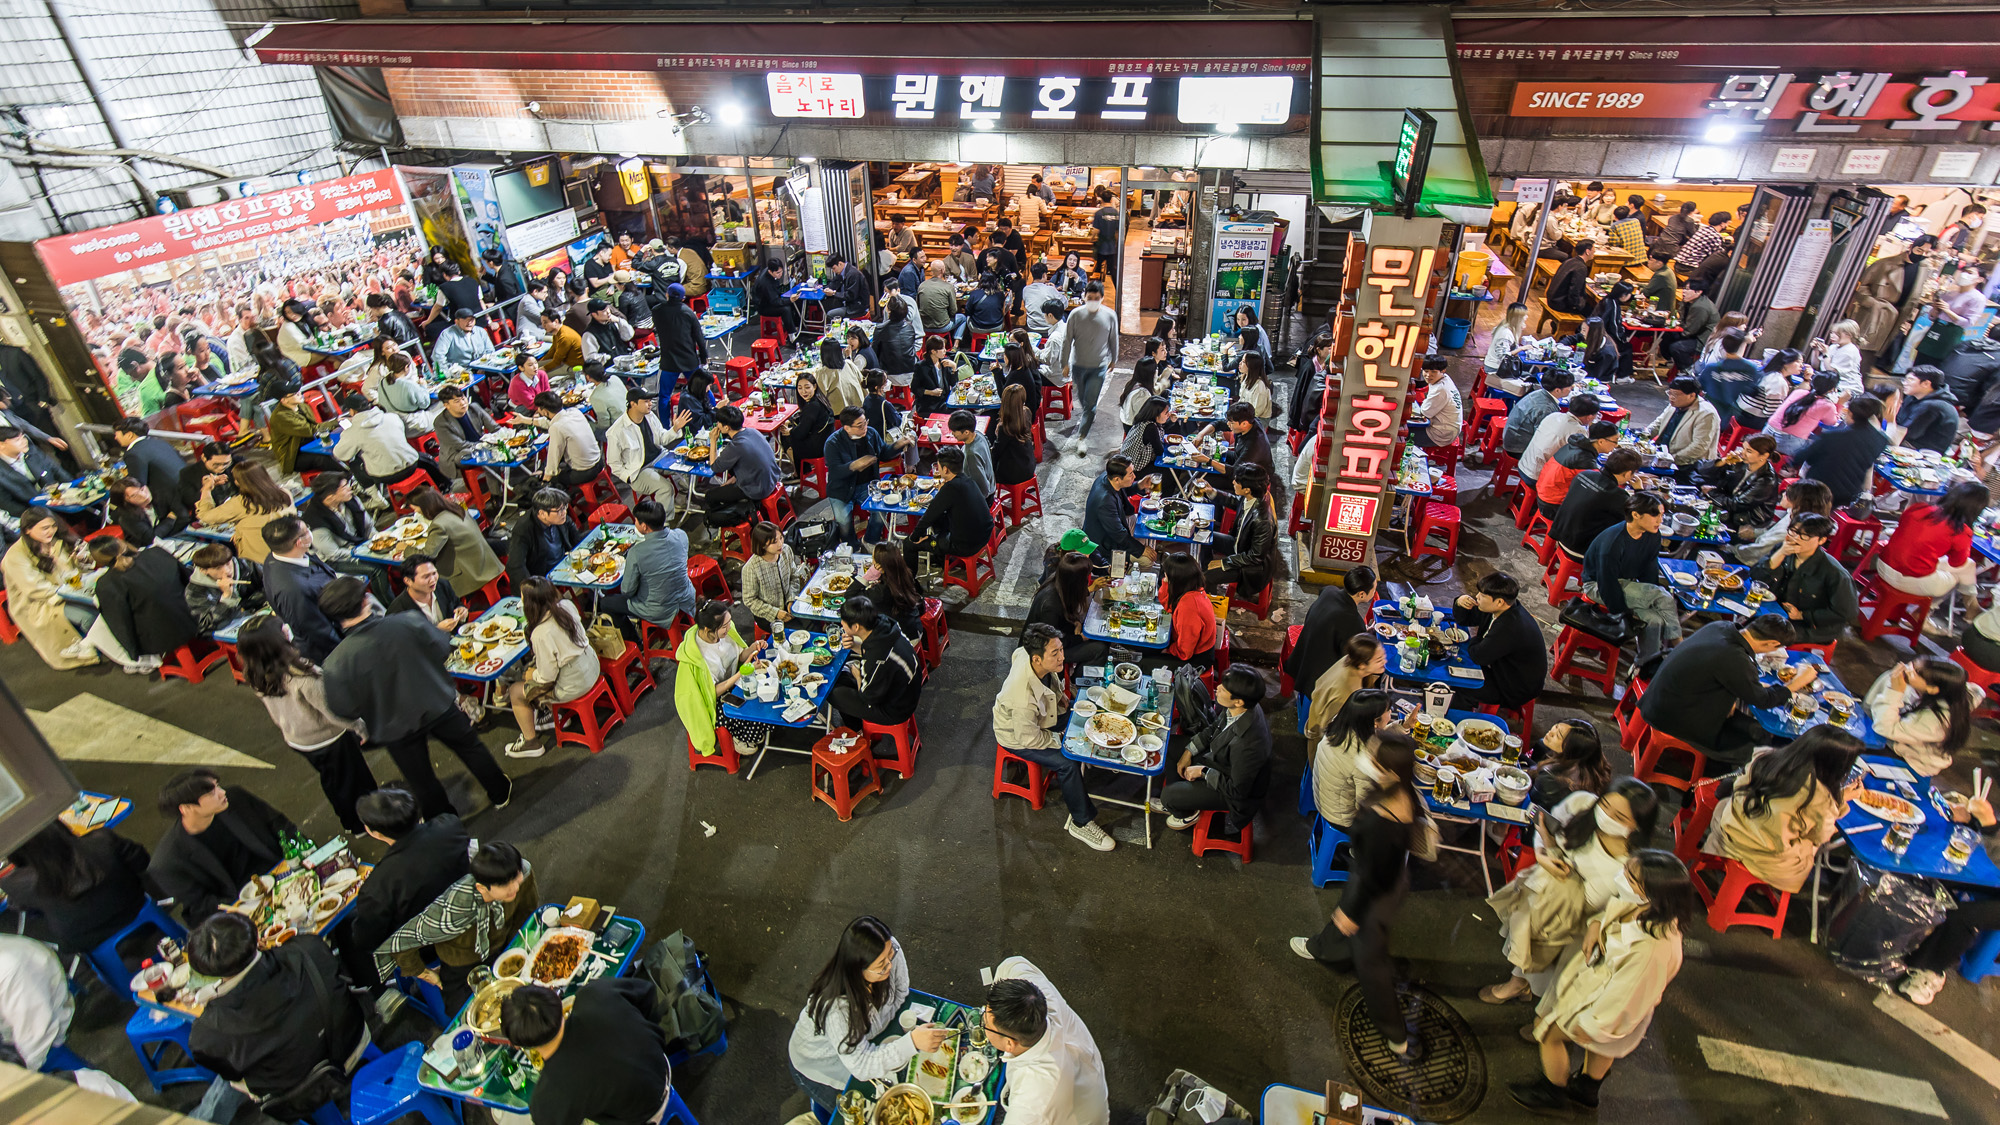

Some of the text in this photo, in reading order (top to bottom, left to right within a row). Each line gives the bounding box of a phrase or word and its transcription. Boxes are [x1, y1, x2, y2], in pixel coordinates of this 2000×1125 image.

[381, 55, 397, 64] Since
[688, 58, 731, 68] 을지로노가리
[781, 60, 799, 69] Since
[801, 60, 818, 69] 1989
[1495, 49, 1557, 60] 을지로노가리
[1561, 50, 1624, 61] 을지로골뱅이
[1628, 50, 1653, 60] Since
[1656, 50, 1680, 60] 1989
[1108, 63, 1307, 73] 뮌헨호프 을지로노가리 을지로골뱅이 Since 1989
[776, 74, 835, 94] 을지로
[891, 74, 1153, 120] 뮌헨호프
[1528, 91, 1644, 109] SINCE 1989
[1707, 70, 2000, 133] 뮌헨호
[797, 97, 856, 116] 노가리
[349, 177, 377, 194] 노가리
[162, 188, 316, 241] 뮌헨호프광장
[244, 222, 272, 238] BEER
[271, 213, 311, 231] SQUARE
[70, 231, 141, 255] welcome
[1220, 239, 1267, 250] 냉수전용냉장고
[113, 241, 167, 264] to visit
[1232, 250, 1252, 258] (Self)
[1336, 248, 1436, 493] 뮌헨호프
[1324, 537, 1364, 551] SINCE
[1323, 546, 1362, 561] 1989
